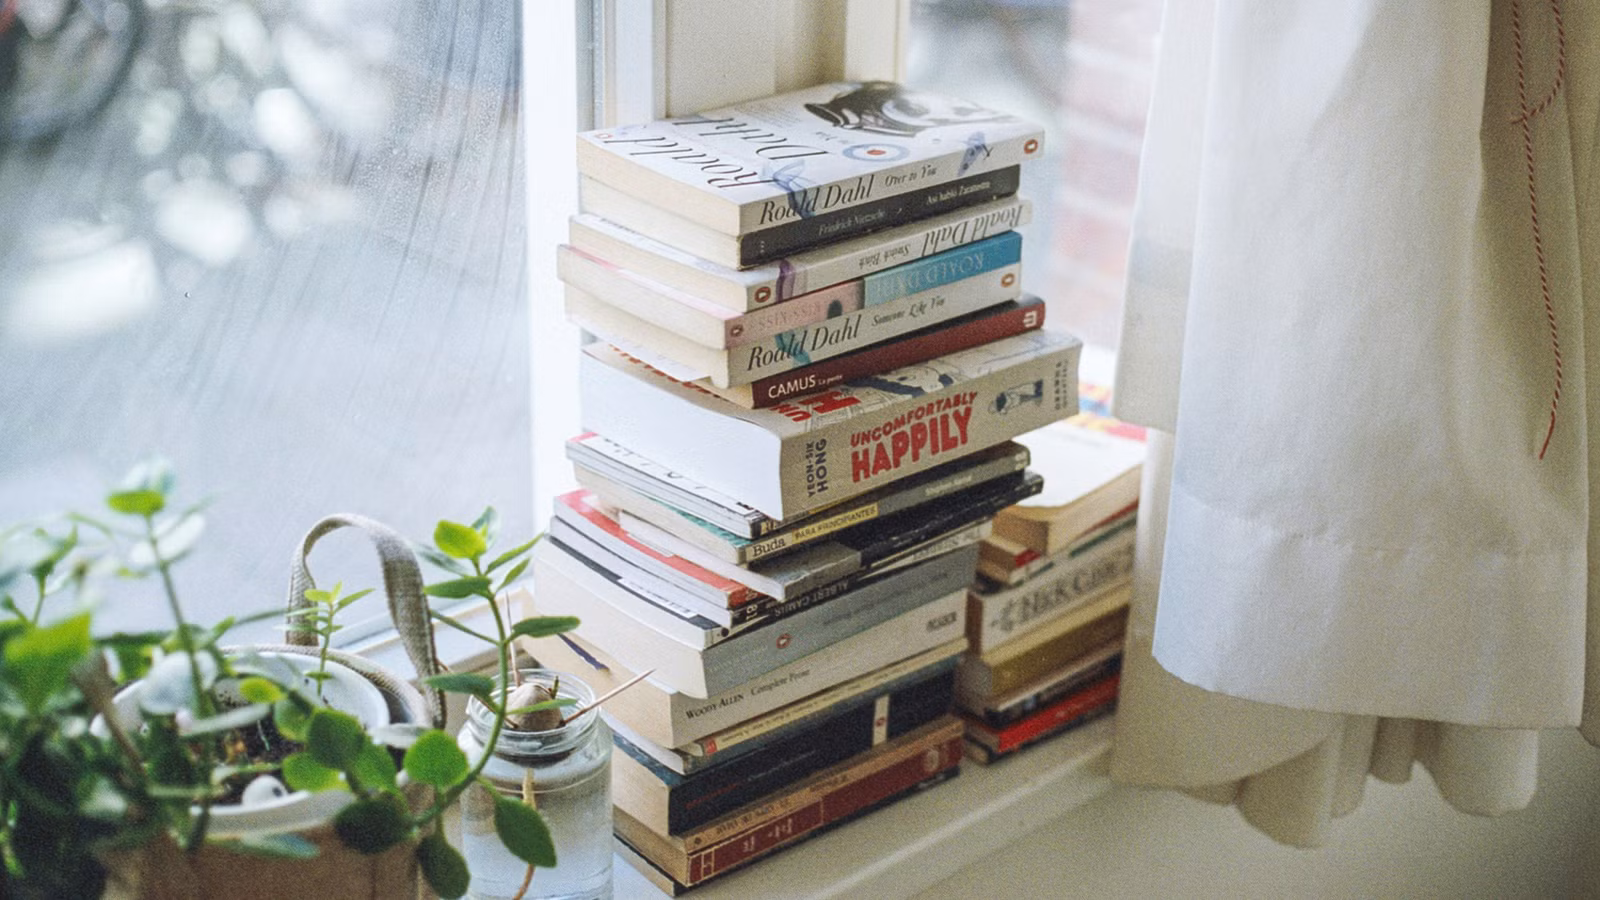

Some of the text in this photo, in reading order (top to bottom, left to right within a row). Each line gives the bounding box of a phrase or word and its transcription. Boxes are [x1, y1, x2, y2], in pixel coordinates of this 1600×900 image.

[672, 118, 828, 160] Dahl
[603, 136, 780, 188] Roald
[760, 187, 820, 225] Roald
[824, 174, 875, 209] Dahl
[885, 173, 907, 187] Over
[920, 165, 937, 179] You
[921, 219, 969, 257] Dahl
[970, 205, 1023, 238] Roald
[747, 329, 808, 371] Roald
[810, 314, 862, 352] Dahl
[768, 375, 816, 398] CAMUS
[850, 391, 977, 447] UNCOMFORTABLY
[815, 438, 829, 493] HONG
[851, 406, 972, 483] HAPPILY
[806, 440, 816, 498] YEON-SIK
[794, 527, 816, 540] PARA
[817, 506, 877, 534] PRINCIPIANTES
[752, 538, 785, 557] Buda
[814, 581, 849, 603] ALBERT
[750, 676, 787, 695] Complete
